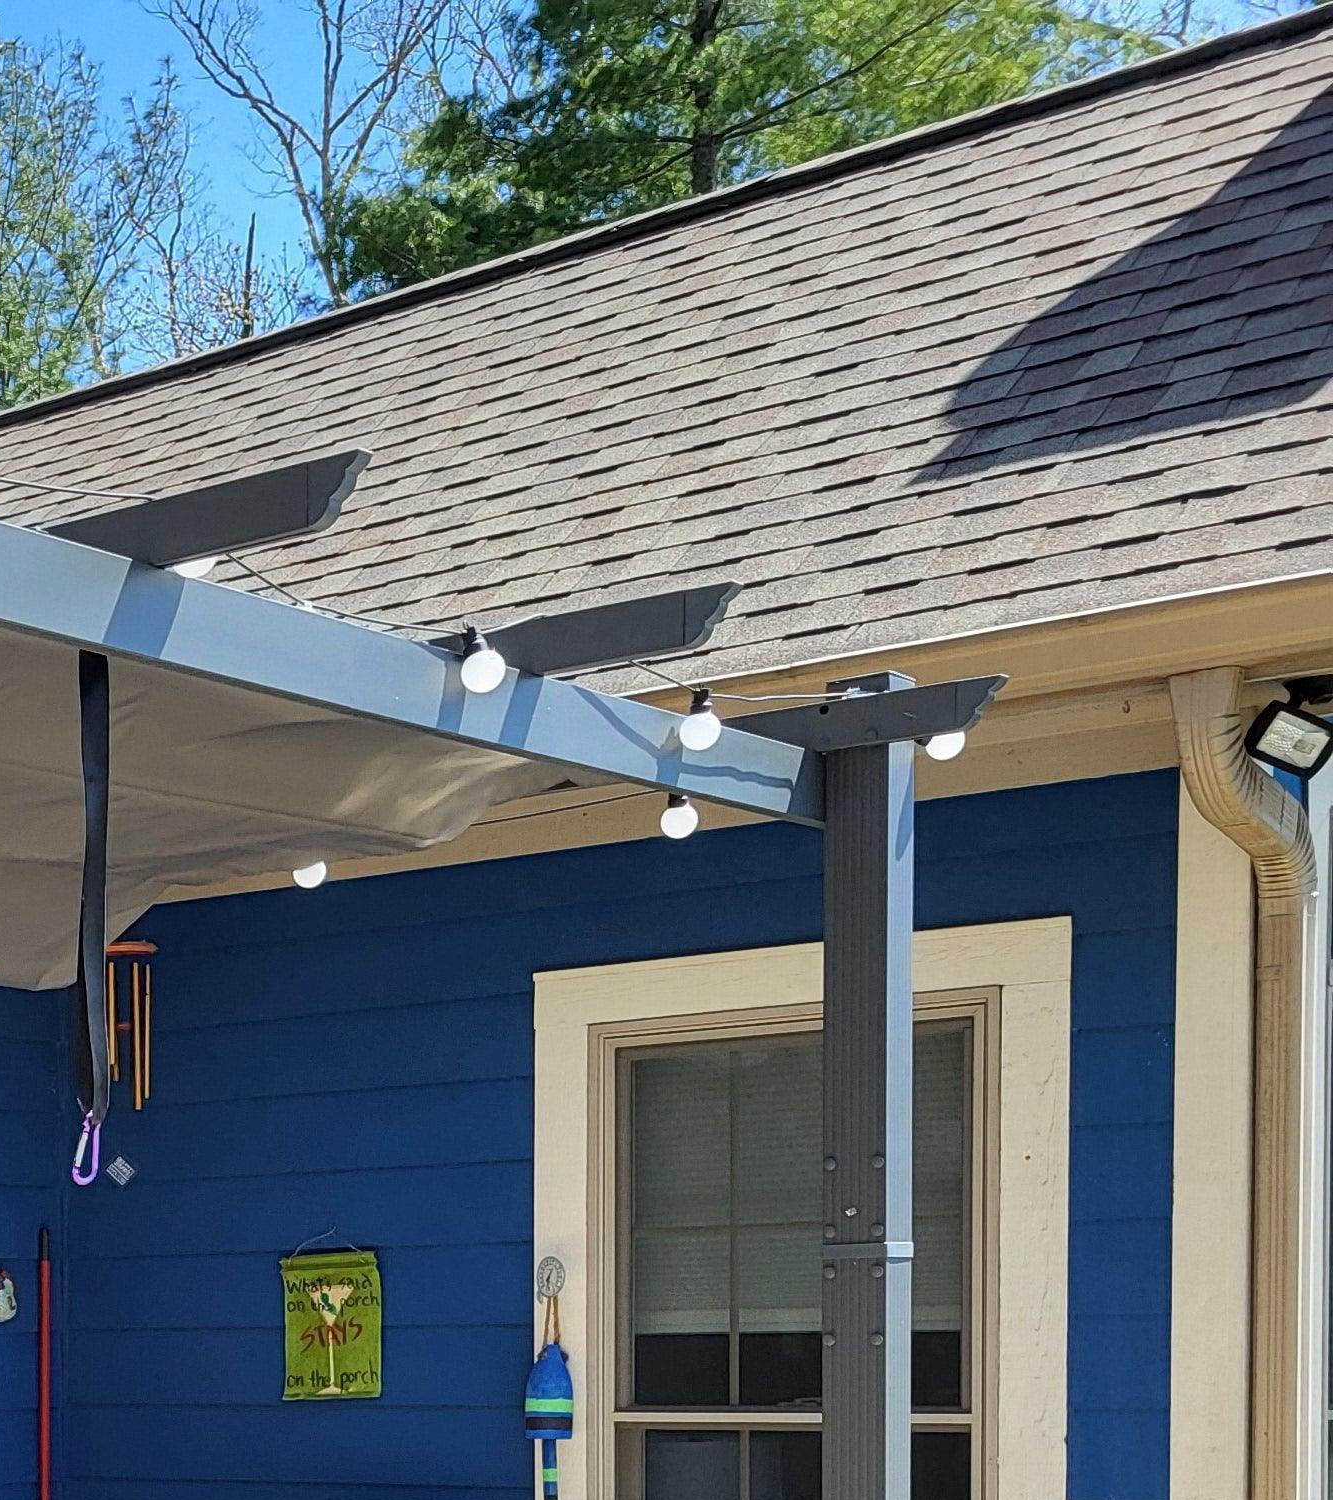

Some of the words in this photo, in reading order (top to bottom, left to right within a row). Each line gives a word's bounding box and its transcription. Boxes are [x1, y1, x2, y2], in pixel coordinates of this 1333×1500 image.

[338, 1271, 373, 1291] said
[286, 1300, 305, 1313] on
[339, 1290, 380, 1317] porch
[299, 1315, 364, 1354] STAYS
[286, 1374, 304, 1388] on
[308, 1369, 332, 1388] the
[340, 1359, 380, 1395] porch
